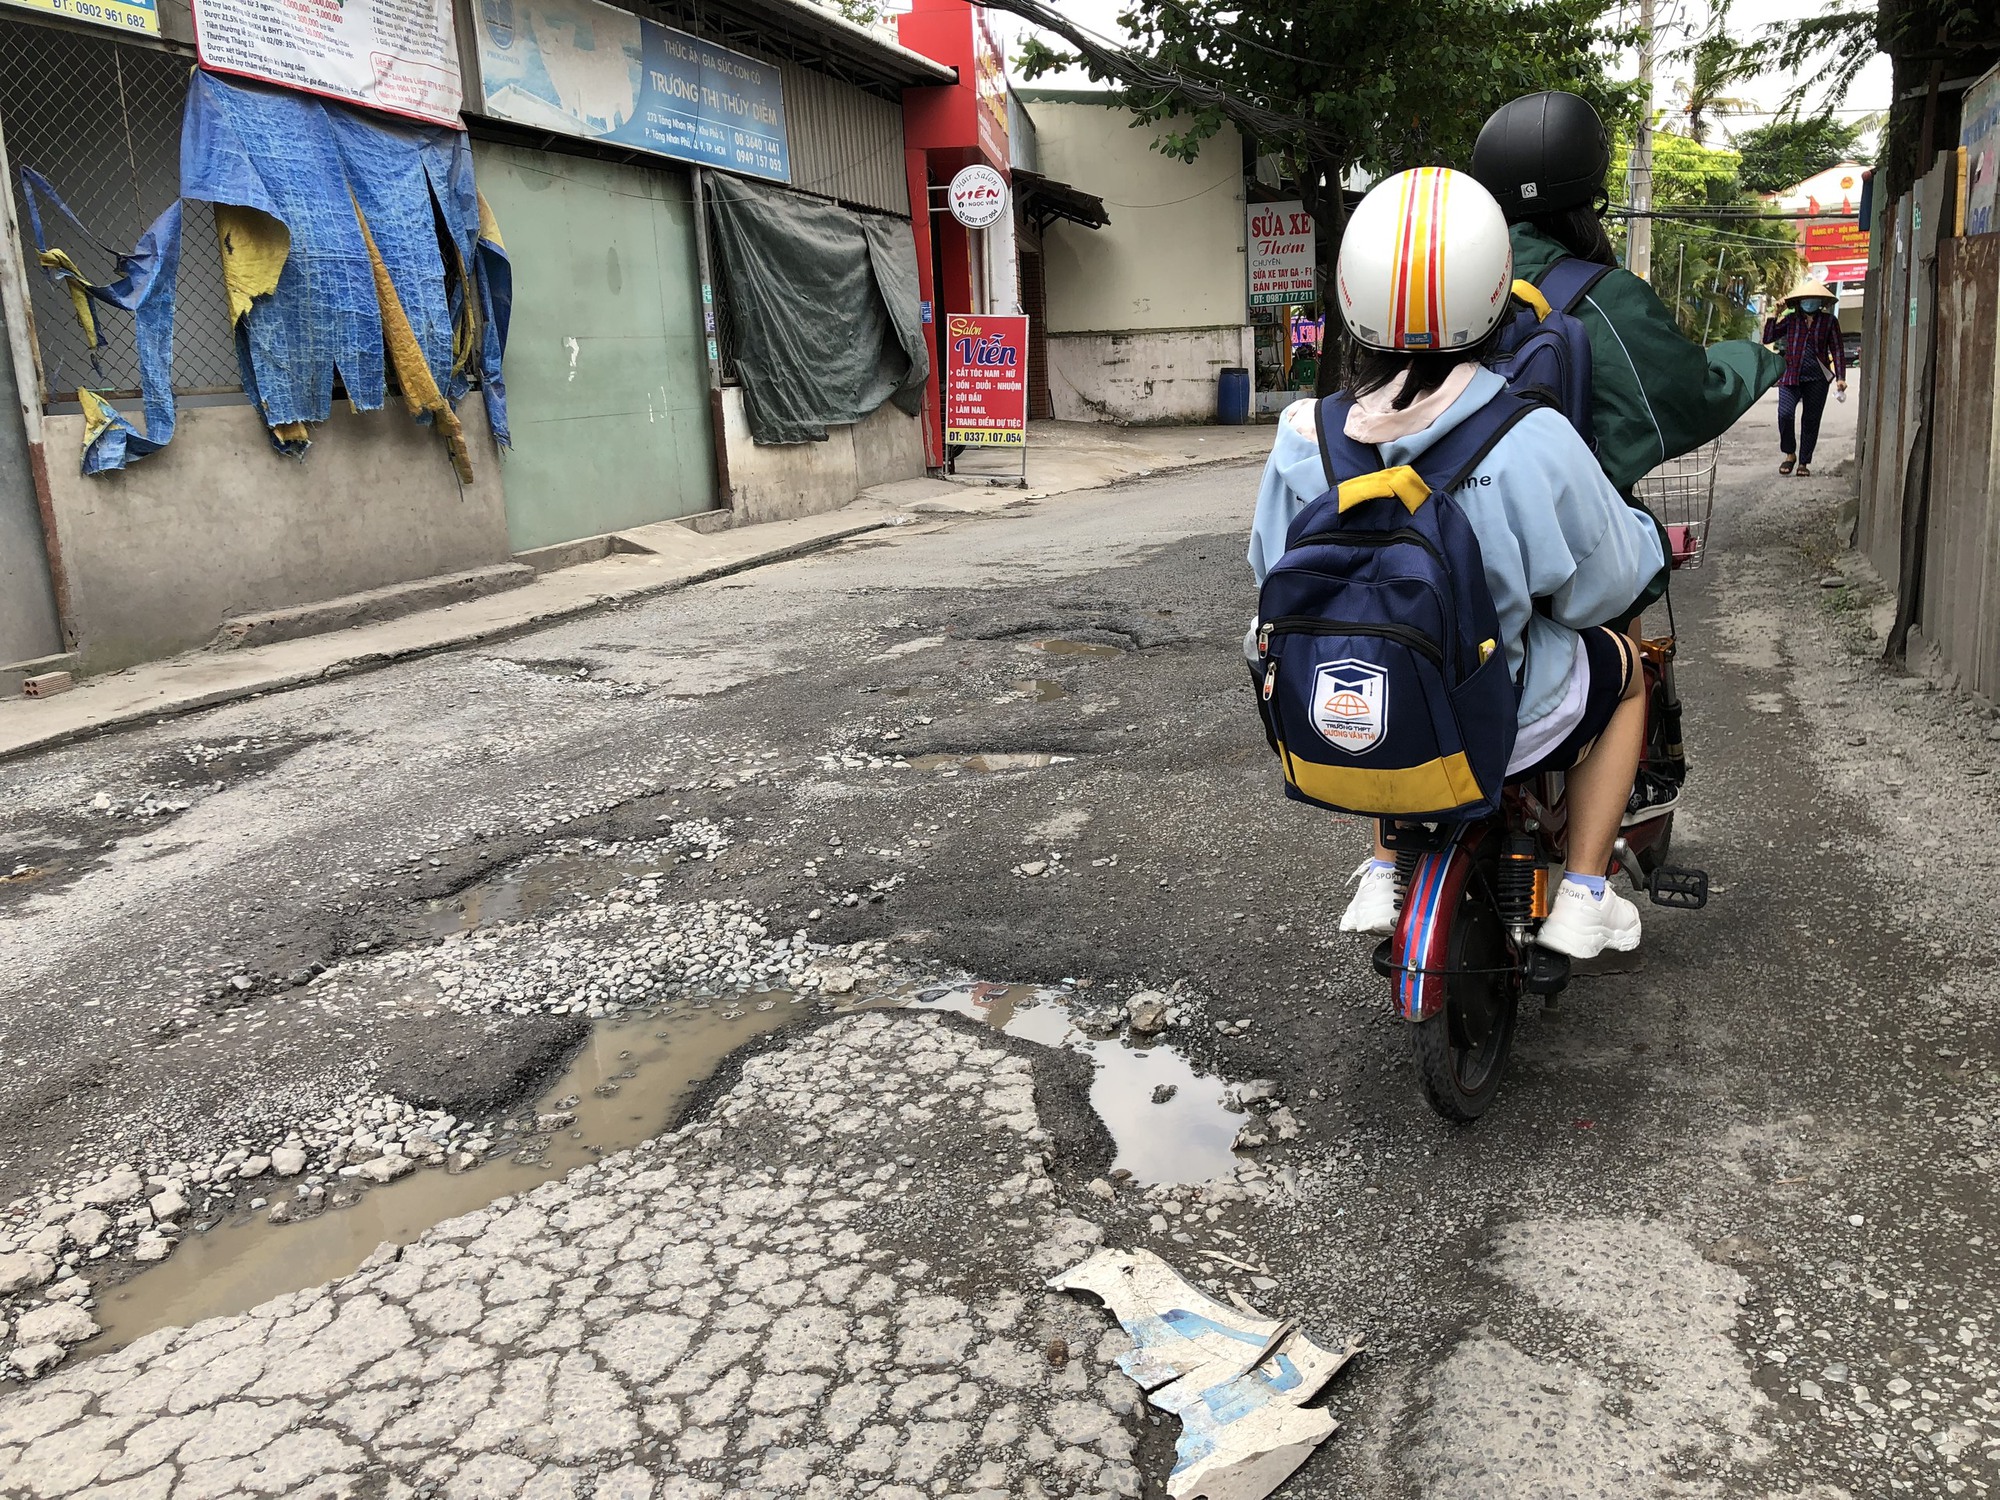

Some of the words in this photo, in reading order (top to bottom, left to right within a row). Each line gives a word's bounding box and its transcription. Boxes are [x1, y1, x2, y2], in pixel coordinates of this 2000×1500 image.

[76, 2, 102, 18] 0902
[106, 10, 122, 23] 961
[127, 13, 145, 28] 682
[702, 54, 716, 69] GIA
[718, 57, 732, 75] SÚC
[734, 65, 749, 80] CON
[650, 70, 699, 103] TRƯƠNG
[701, 87, 720, 112] THỊ
[647, 112, 657, 122] 273
[699, 126, 708, 136] Khu
[715, 145, 726, 155] HCM
[734, 132, 743, 146] 08
[746, 135, 763, 151] 3640
[765, 142, 780, 156] 1441
[736, 149, 753, 164] 0949
[756, 154, 767, 168] 157
[770, 159, 782, 172] 052
[956, 174, 972, 191] Hair
[974, 170, 997, 186] Salon
[989, 209, 998, 219] 054
[1252, 207, 1285, 238] SỬA
[1289, 213, 1311, 236] XE
[1257, 239, 1306, 257] Thơm
[1253, 267, 1266, 280] SỬA
[1268, 270, 1276, 279] XE
[1278, 268, 1288, 278] TAY
[1290, 268, 1299, 277] GA
[1305, 267, 1312, 276] F1
[1253, 281, 1270, 292] BÁN
[1273, 281, 1289, 292] PHỤ
[1291, 278, 1312, 289] TÙNG
[1490, 272, 1506, 304] HEAD
[1254, 294, 1265, 304] ĐT:
[1266, 293, 1283, 303] 0987
[1285, 292, 1298, 301] 177
[1300, 291, 1313, 300] 211
[950, 318, 982, 337] Salon
[955, 333, 1017, 366] Viễn
[956, 367, 969, 378] CẮT
[970, 368, 983, 378] TÓC
[984, 370, 1000, 378] NAM
[1006, 369, 1016, 378] NỮ
[997, 382, 1022, 392] NHUỘM
[968, 392, 982, 402] ĐẦU
[956, 405, 970, 414] LÀM
[971, 405, 986, 414] NAIL
[956, 418, 976, 426] TRANG
[996, 418, 1006, 427] DỰ
[1007, 418, 1021, 428] TIỆC
[950, 431, 962, 441] ĐT:
[964, 432, 1022, 443] 0337.107.054
[1561, 888, 1585, 900] SPORT
